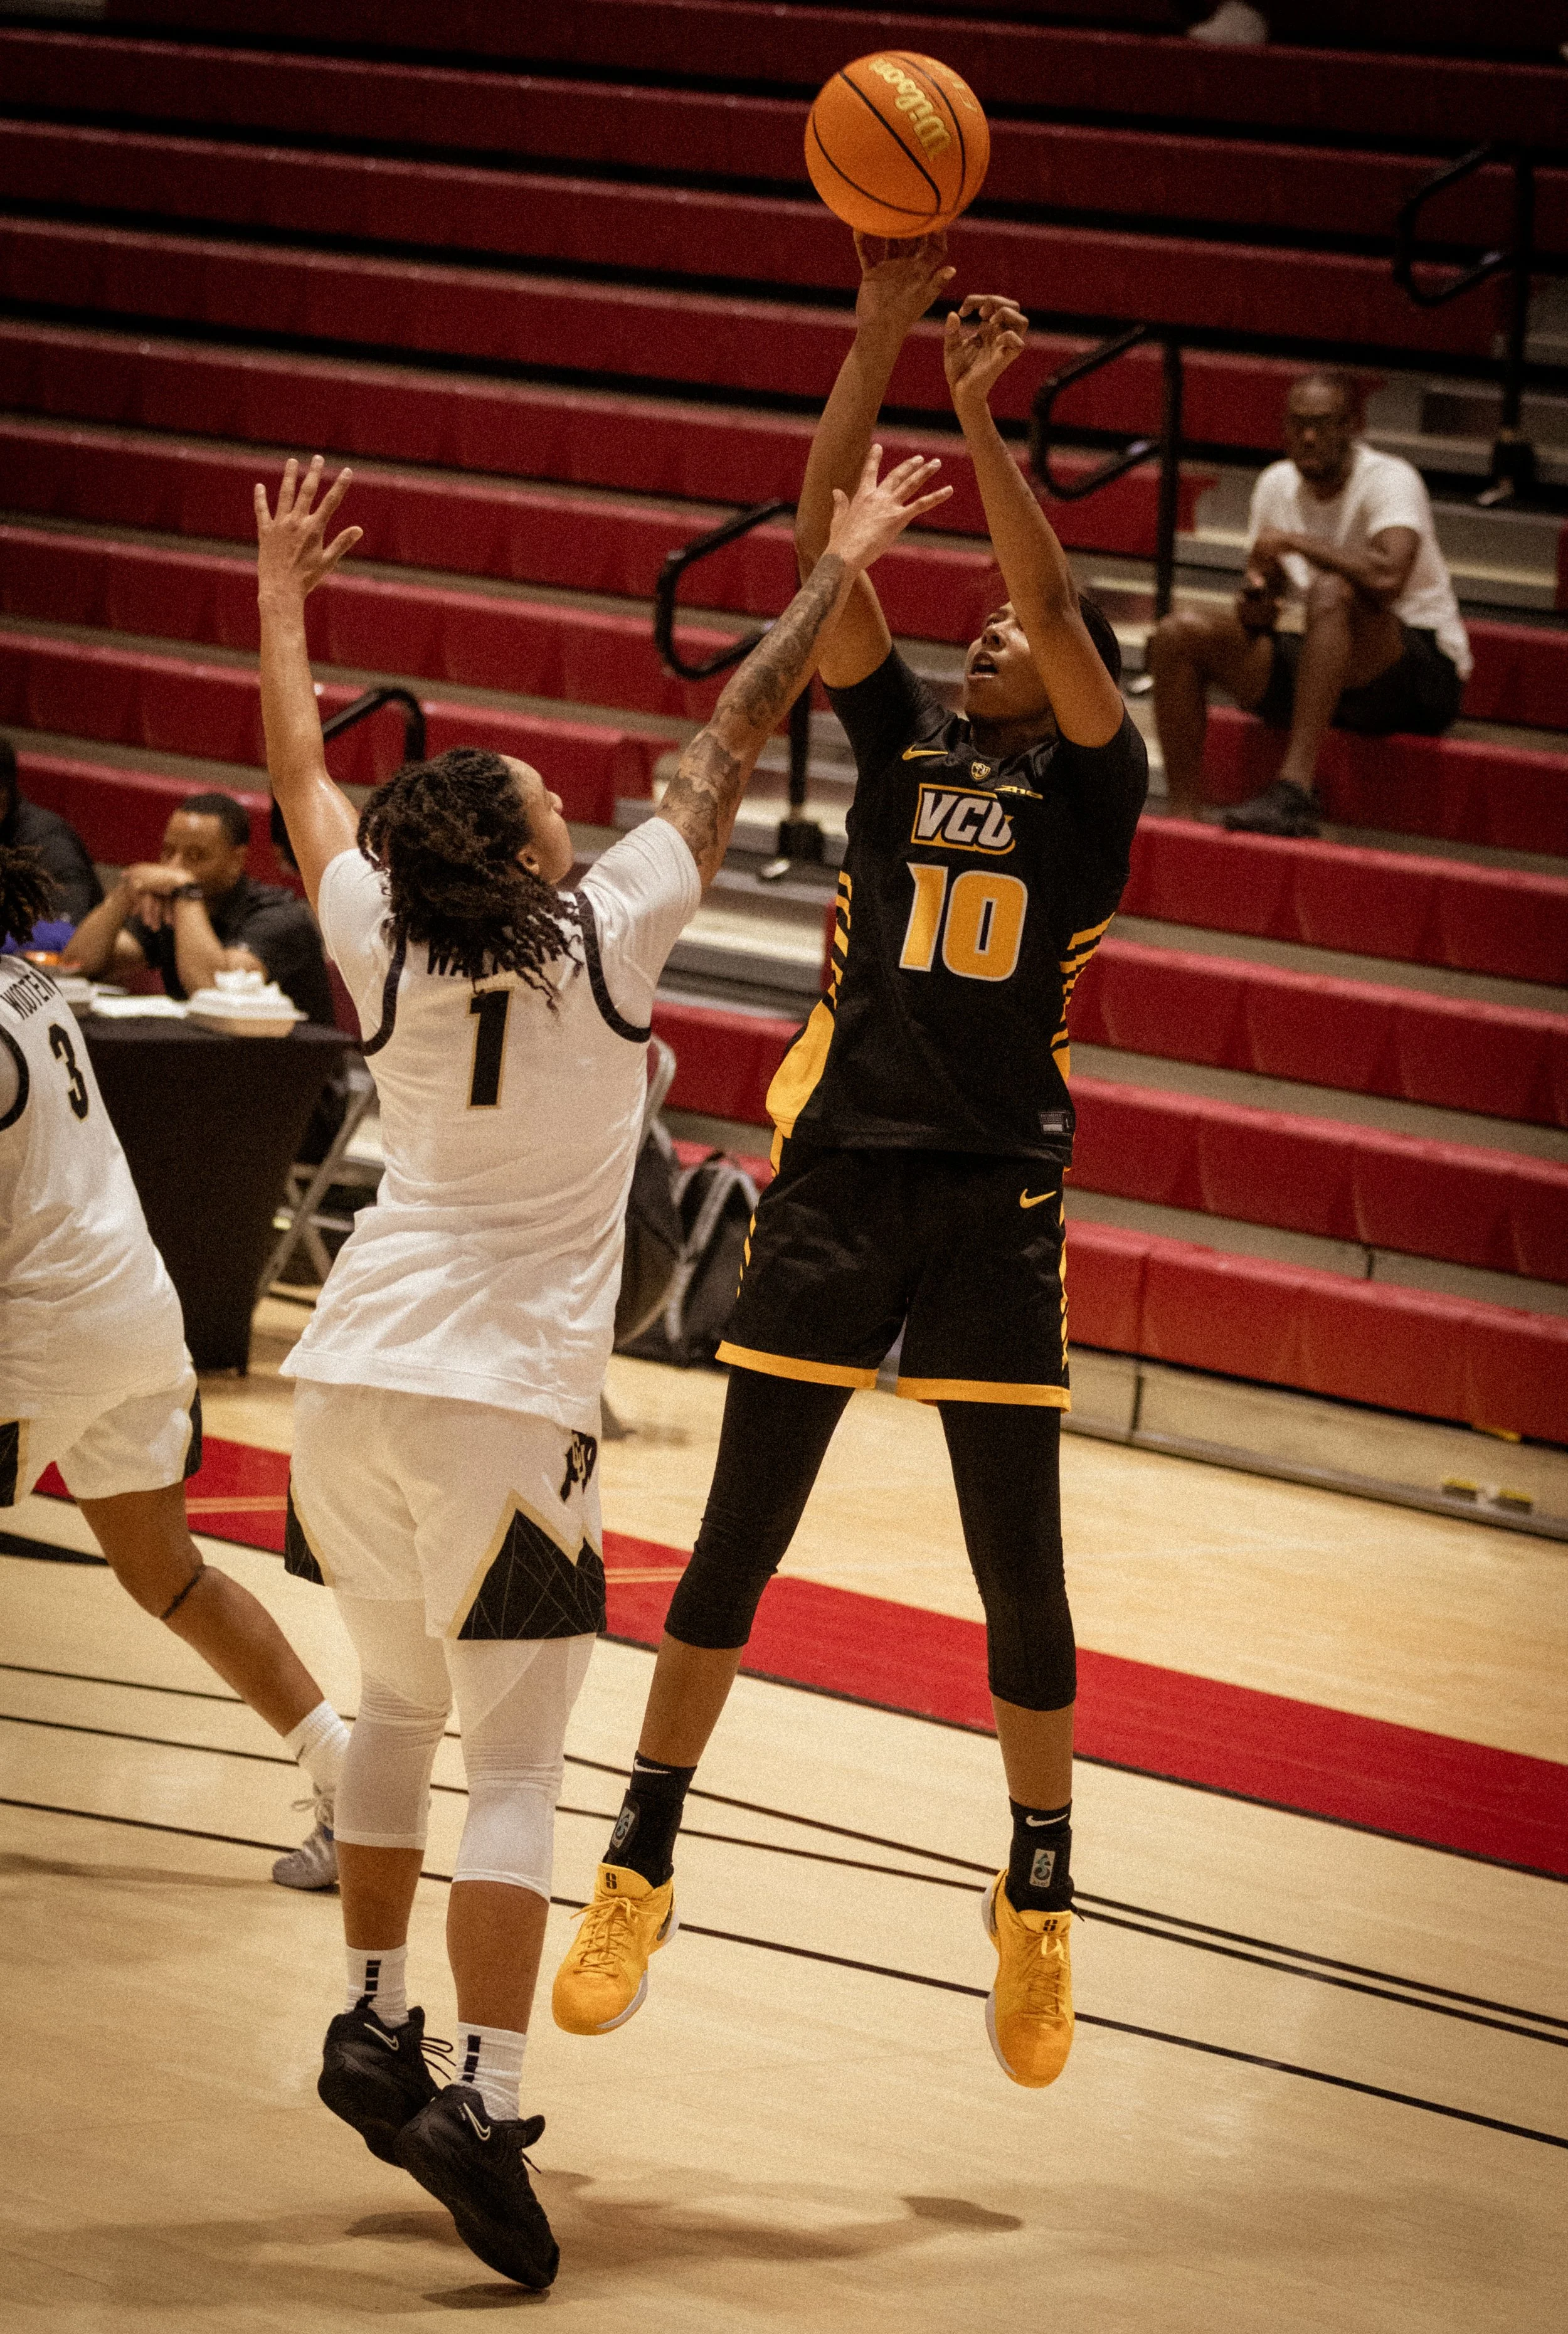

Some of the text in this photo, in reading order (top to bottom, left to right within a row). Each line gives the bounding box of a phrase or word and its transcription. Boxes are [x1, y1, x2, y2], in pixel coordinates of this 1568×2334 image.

[916, 790, 1013, 849] VCU
[899, 862, 1028, 982] 10
[48, 1023, 88, 1122] 3
[465, 987, 514, 1110] 1
